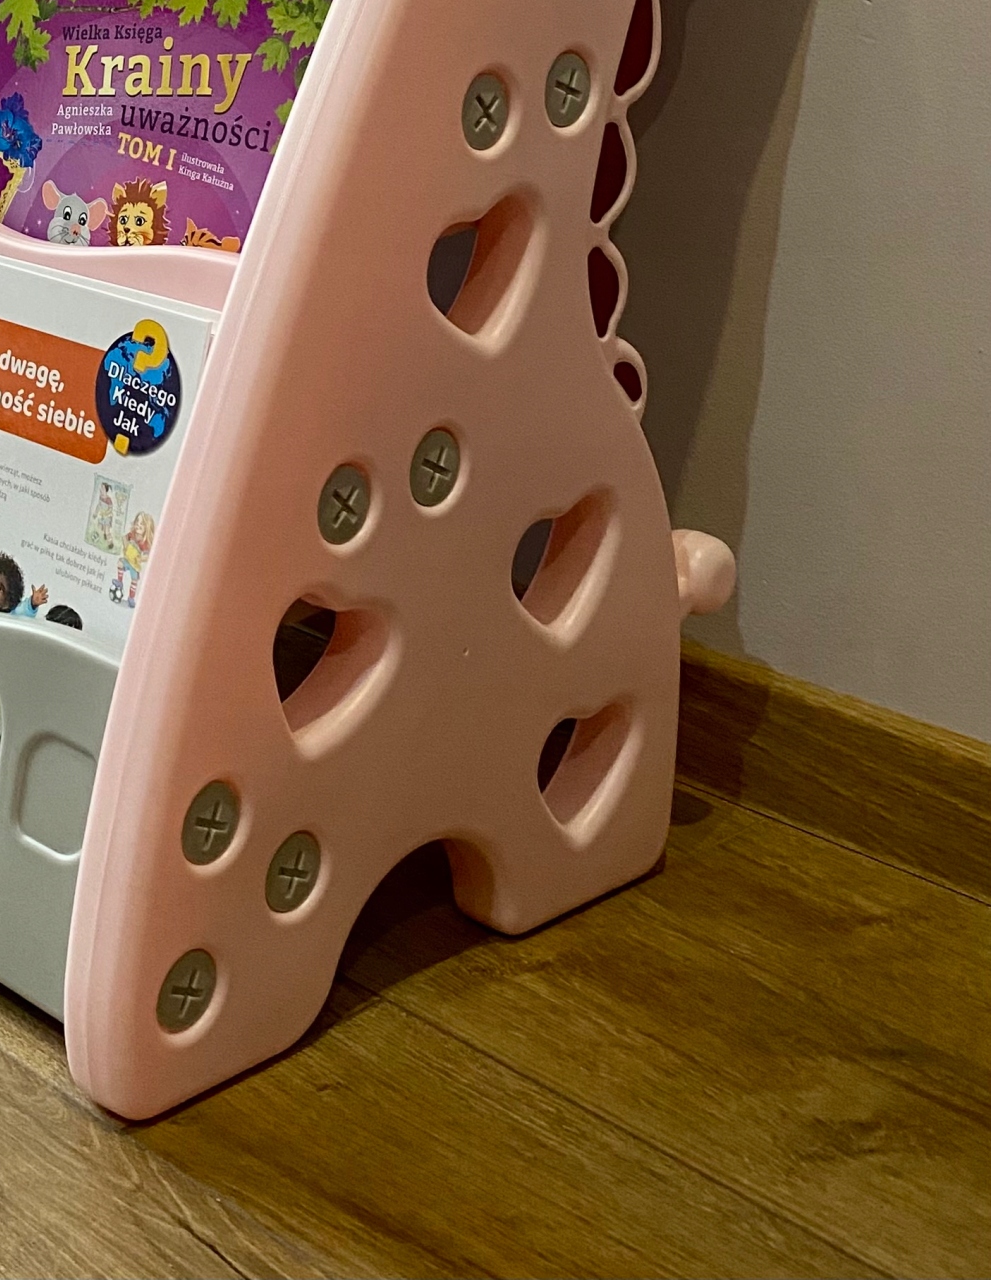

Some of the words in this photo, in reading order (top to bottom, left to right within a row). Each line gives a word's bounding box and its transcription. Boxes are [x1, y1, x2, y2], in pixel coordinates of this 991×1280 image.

[62, 26, 111, 41] Wielka
[114, 23, 163, 44] Księga
[62, 36, 252, 115] Krainy
[57, 104, 113, 119] Agnieszka
[51, 122, 112, 136] Pawłowska
[120, 104, 272, 152] uważności
[117, 132, 163, 167] TOM
[166, 148, 177, 171] I
[181, 152, 225, 174] ilustrowała
[178, 164, 200, 181] Kinga
[202, 172, 234, 191] Kałużna
[108, 361, 177, 407] Dlaczego
[36, 400, 96, 439] siebie
[112, 386, 156, 424] Kiedy
[113, 410, 139, 437] Jak
